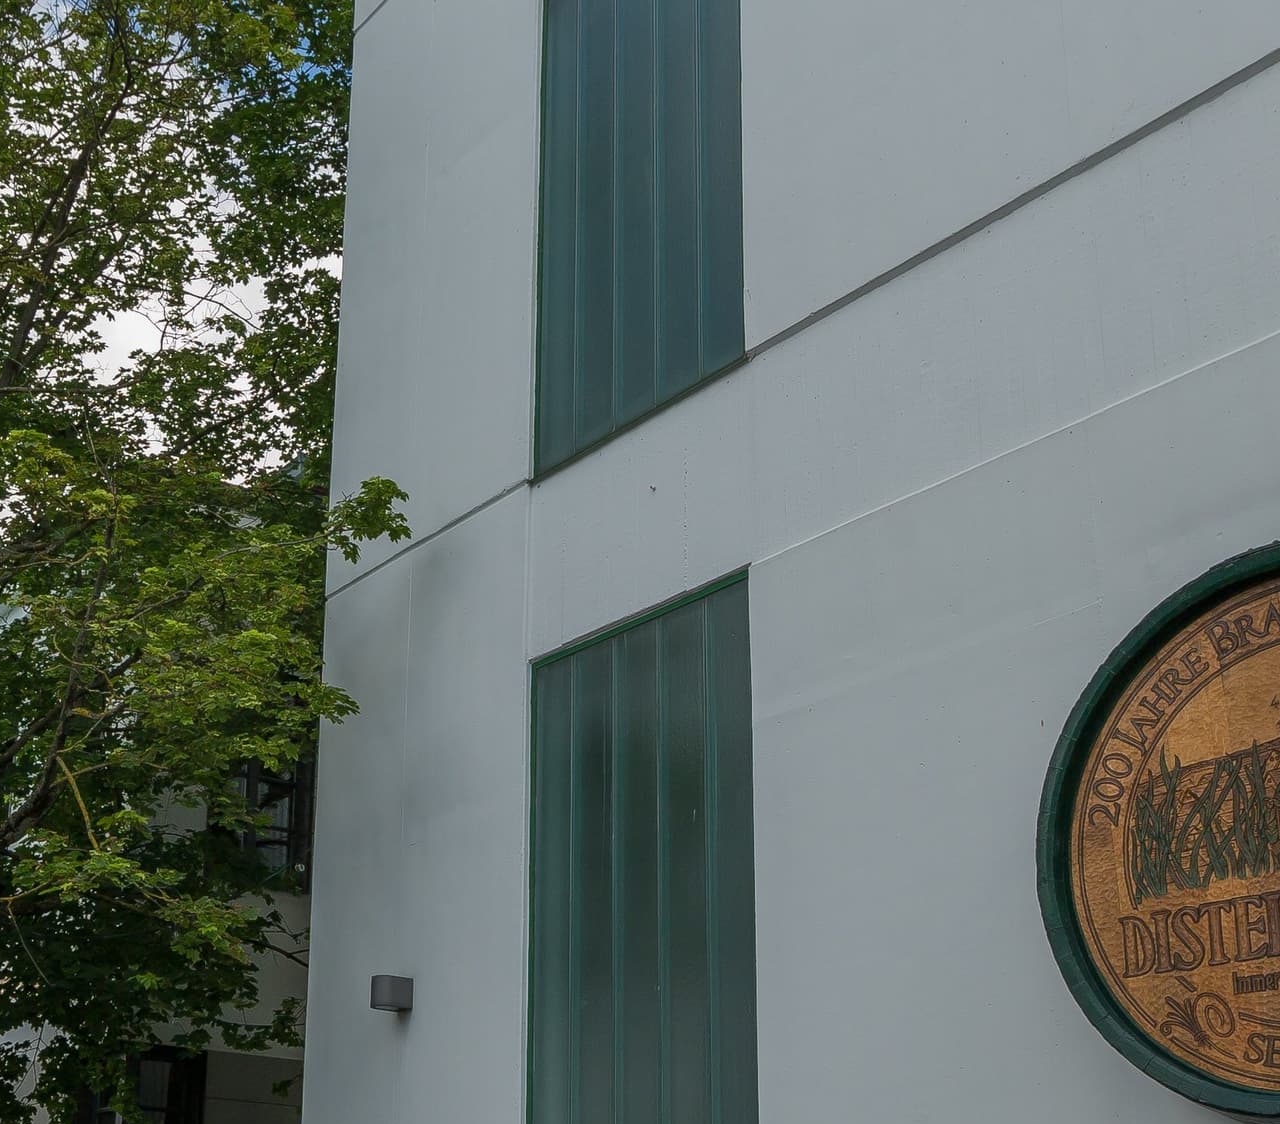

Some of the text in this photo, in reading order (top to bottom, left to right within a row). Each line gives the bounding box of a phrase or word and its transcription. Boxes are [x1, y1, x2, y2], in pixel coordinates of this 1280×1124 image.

[1088, 752, 1133, 828] 200
[1112, 645, 1211, 758] JAHRE
[1231, 971, 1280, 995] Immer
